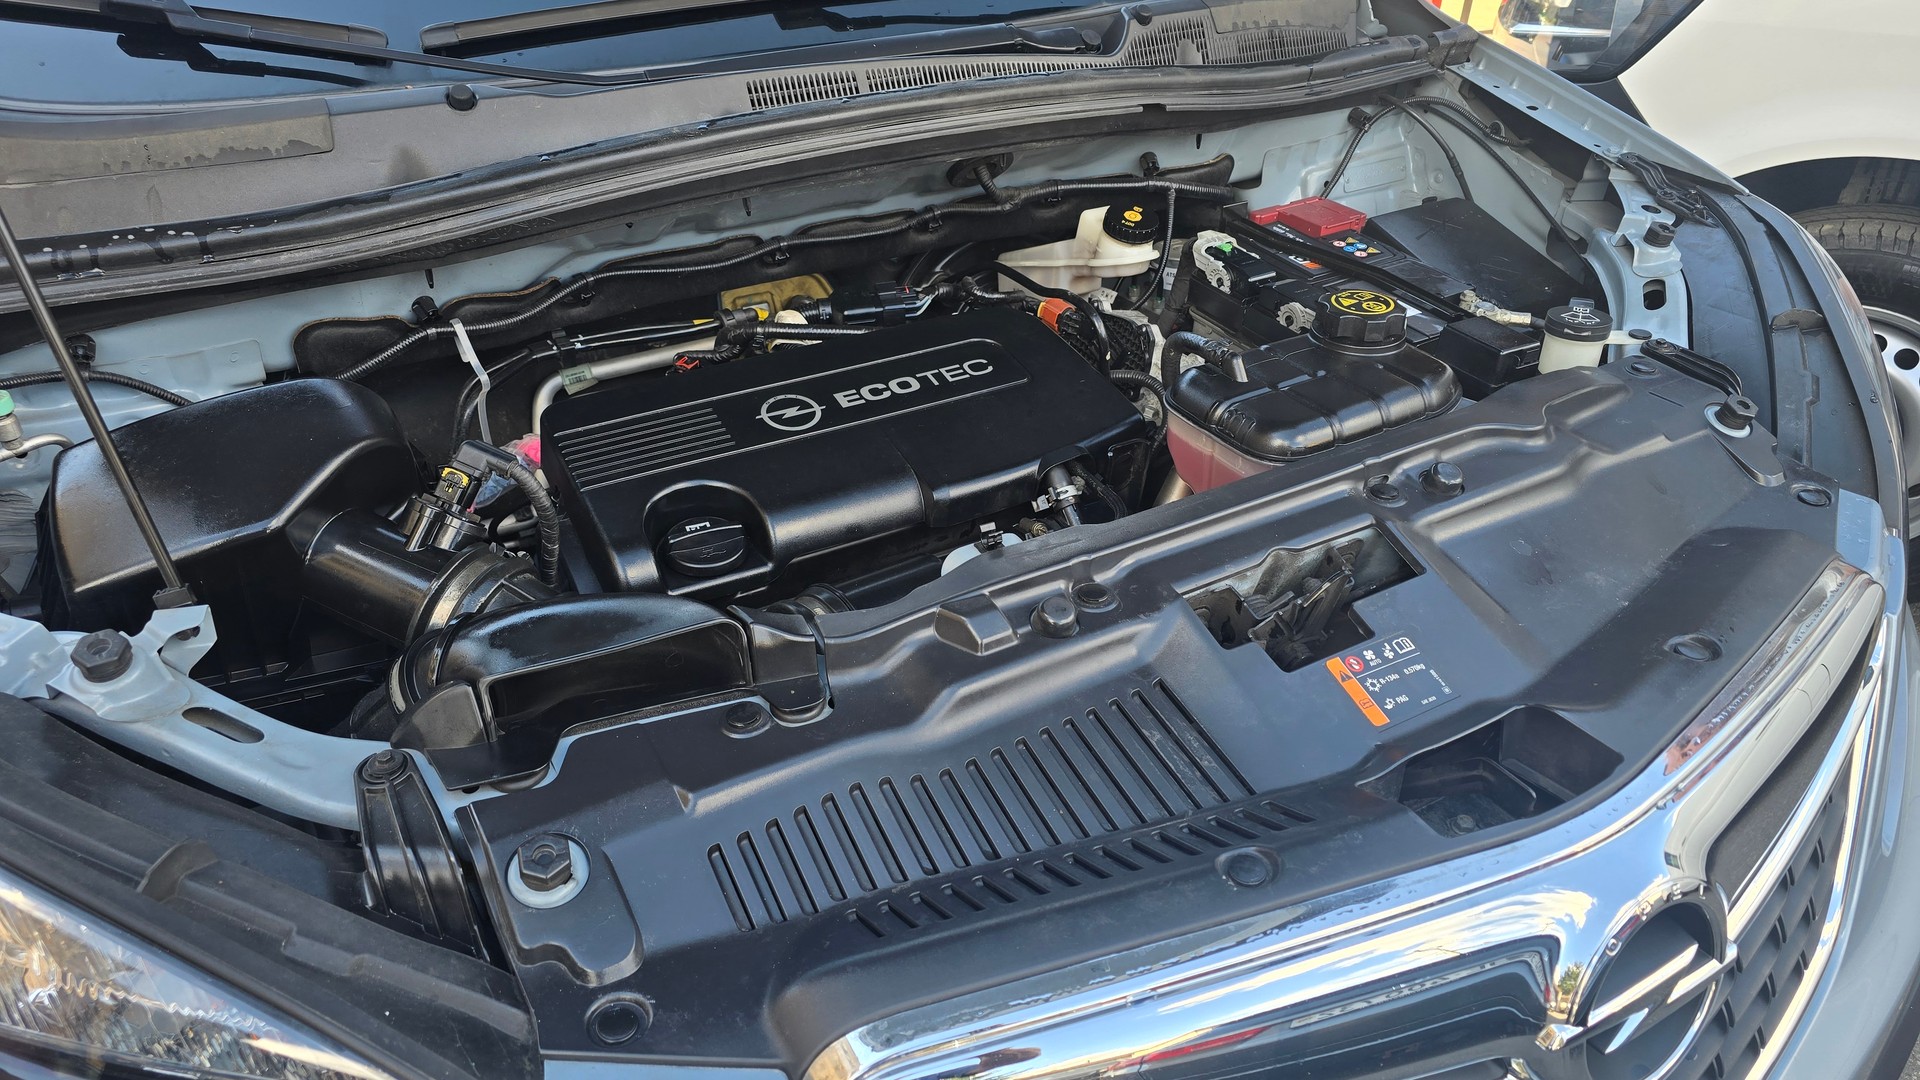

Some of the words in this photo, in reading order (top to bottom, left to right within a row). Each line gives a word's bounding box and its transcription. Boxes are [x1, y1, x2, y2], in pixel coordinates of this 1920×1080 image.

[833, 358, 993, 408] ECOTEC
[1369, 658, 1382, 667] AUTO
[1379, 673, 1400, 685] R-134a
[1395, 694, 1409, 704] PAG
[1605, 882, 1706, 956] OPEL
